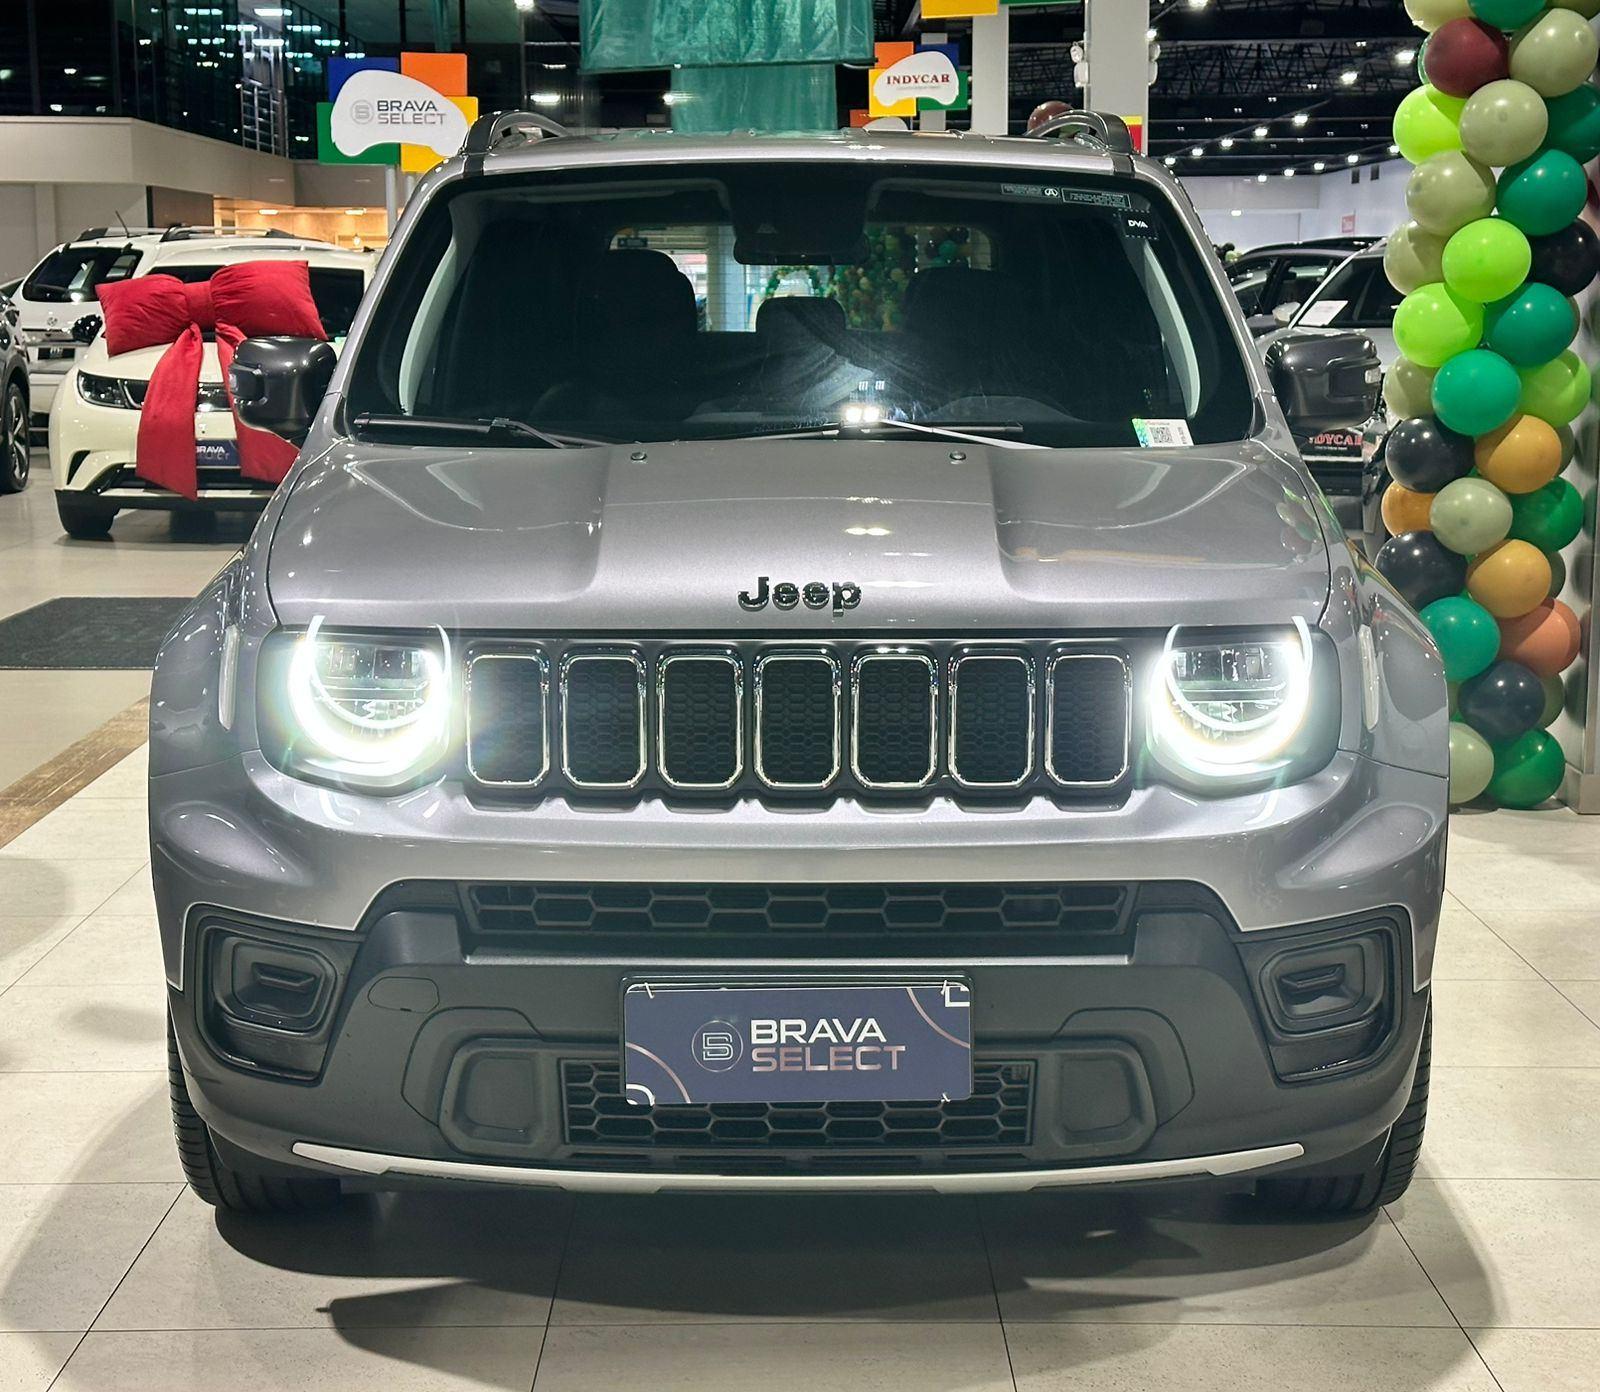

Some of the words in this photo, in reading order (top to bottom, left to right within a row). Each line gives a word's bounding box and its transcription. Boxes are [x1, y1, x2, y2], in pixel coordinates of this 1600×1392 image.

[886, 73, 951, 85] INDYCAR
[376, 99, 438, 112] BRAVA
[377, 112, 447, 125] SELECT
[738, 576, 862, 617] Jeep
[750, 1017, 888, 1045] BRAVA
[751, 1045, 907, 1073] SELECT
